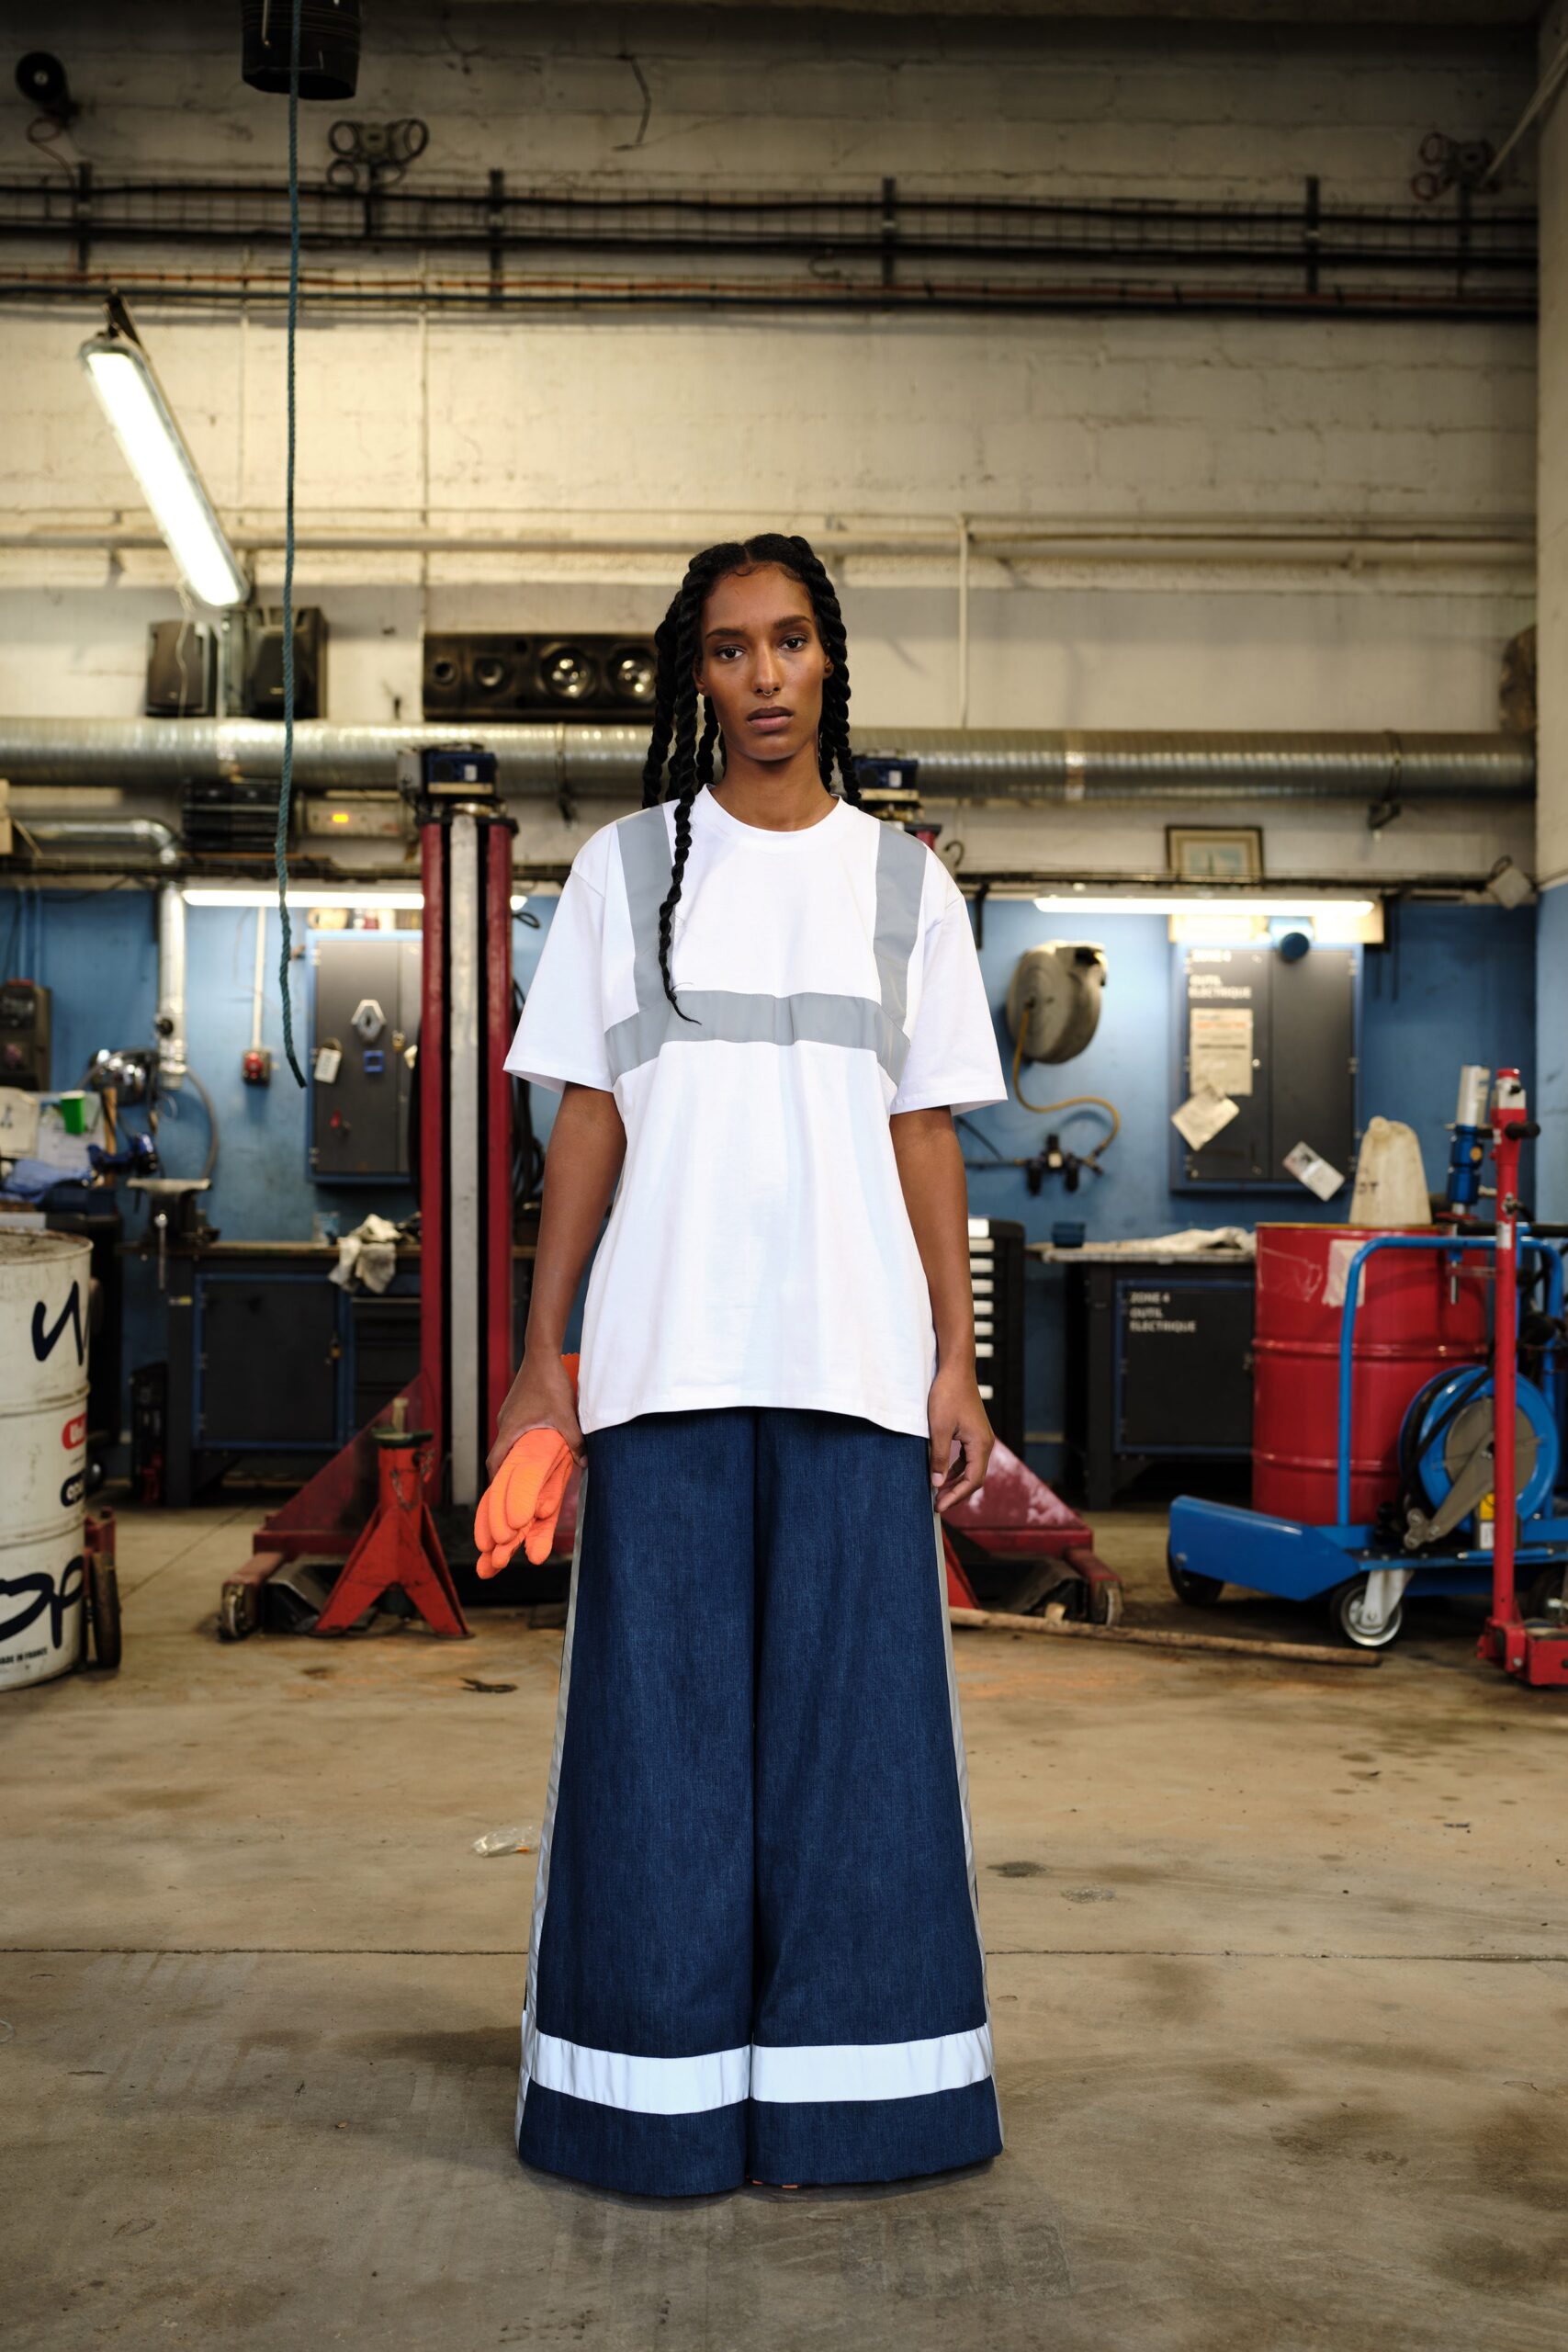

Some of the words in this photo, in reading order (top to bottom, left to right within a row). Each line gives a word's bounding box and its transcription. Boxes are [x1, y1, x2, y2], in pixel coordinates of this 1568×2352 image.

[1130, 1291, 1160, 1304] ZONE
[1162, 1291, 1170, 1304] 4
[1129, 1306, 1163, 1319] OUTIL
